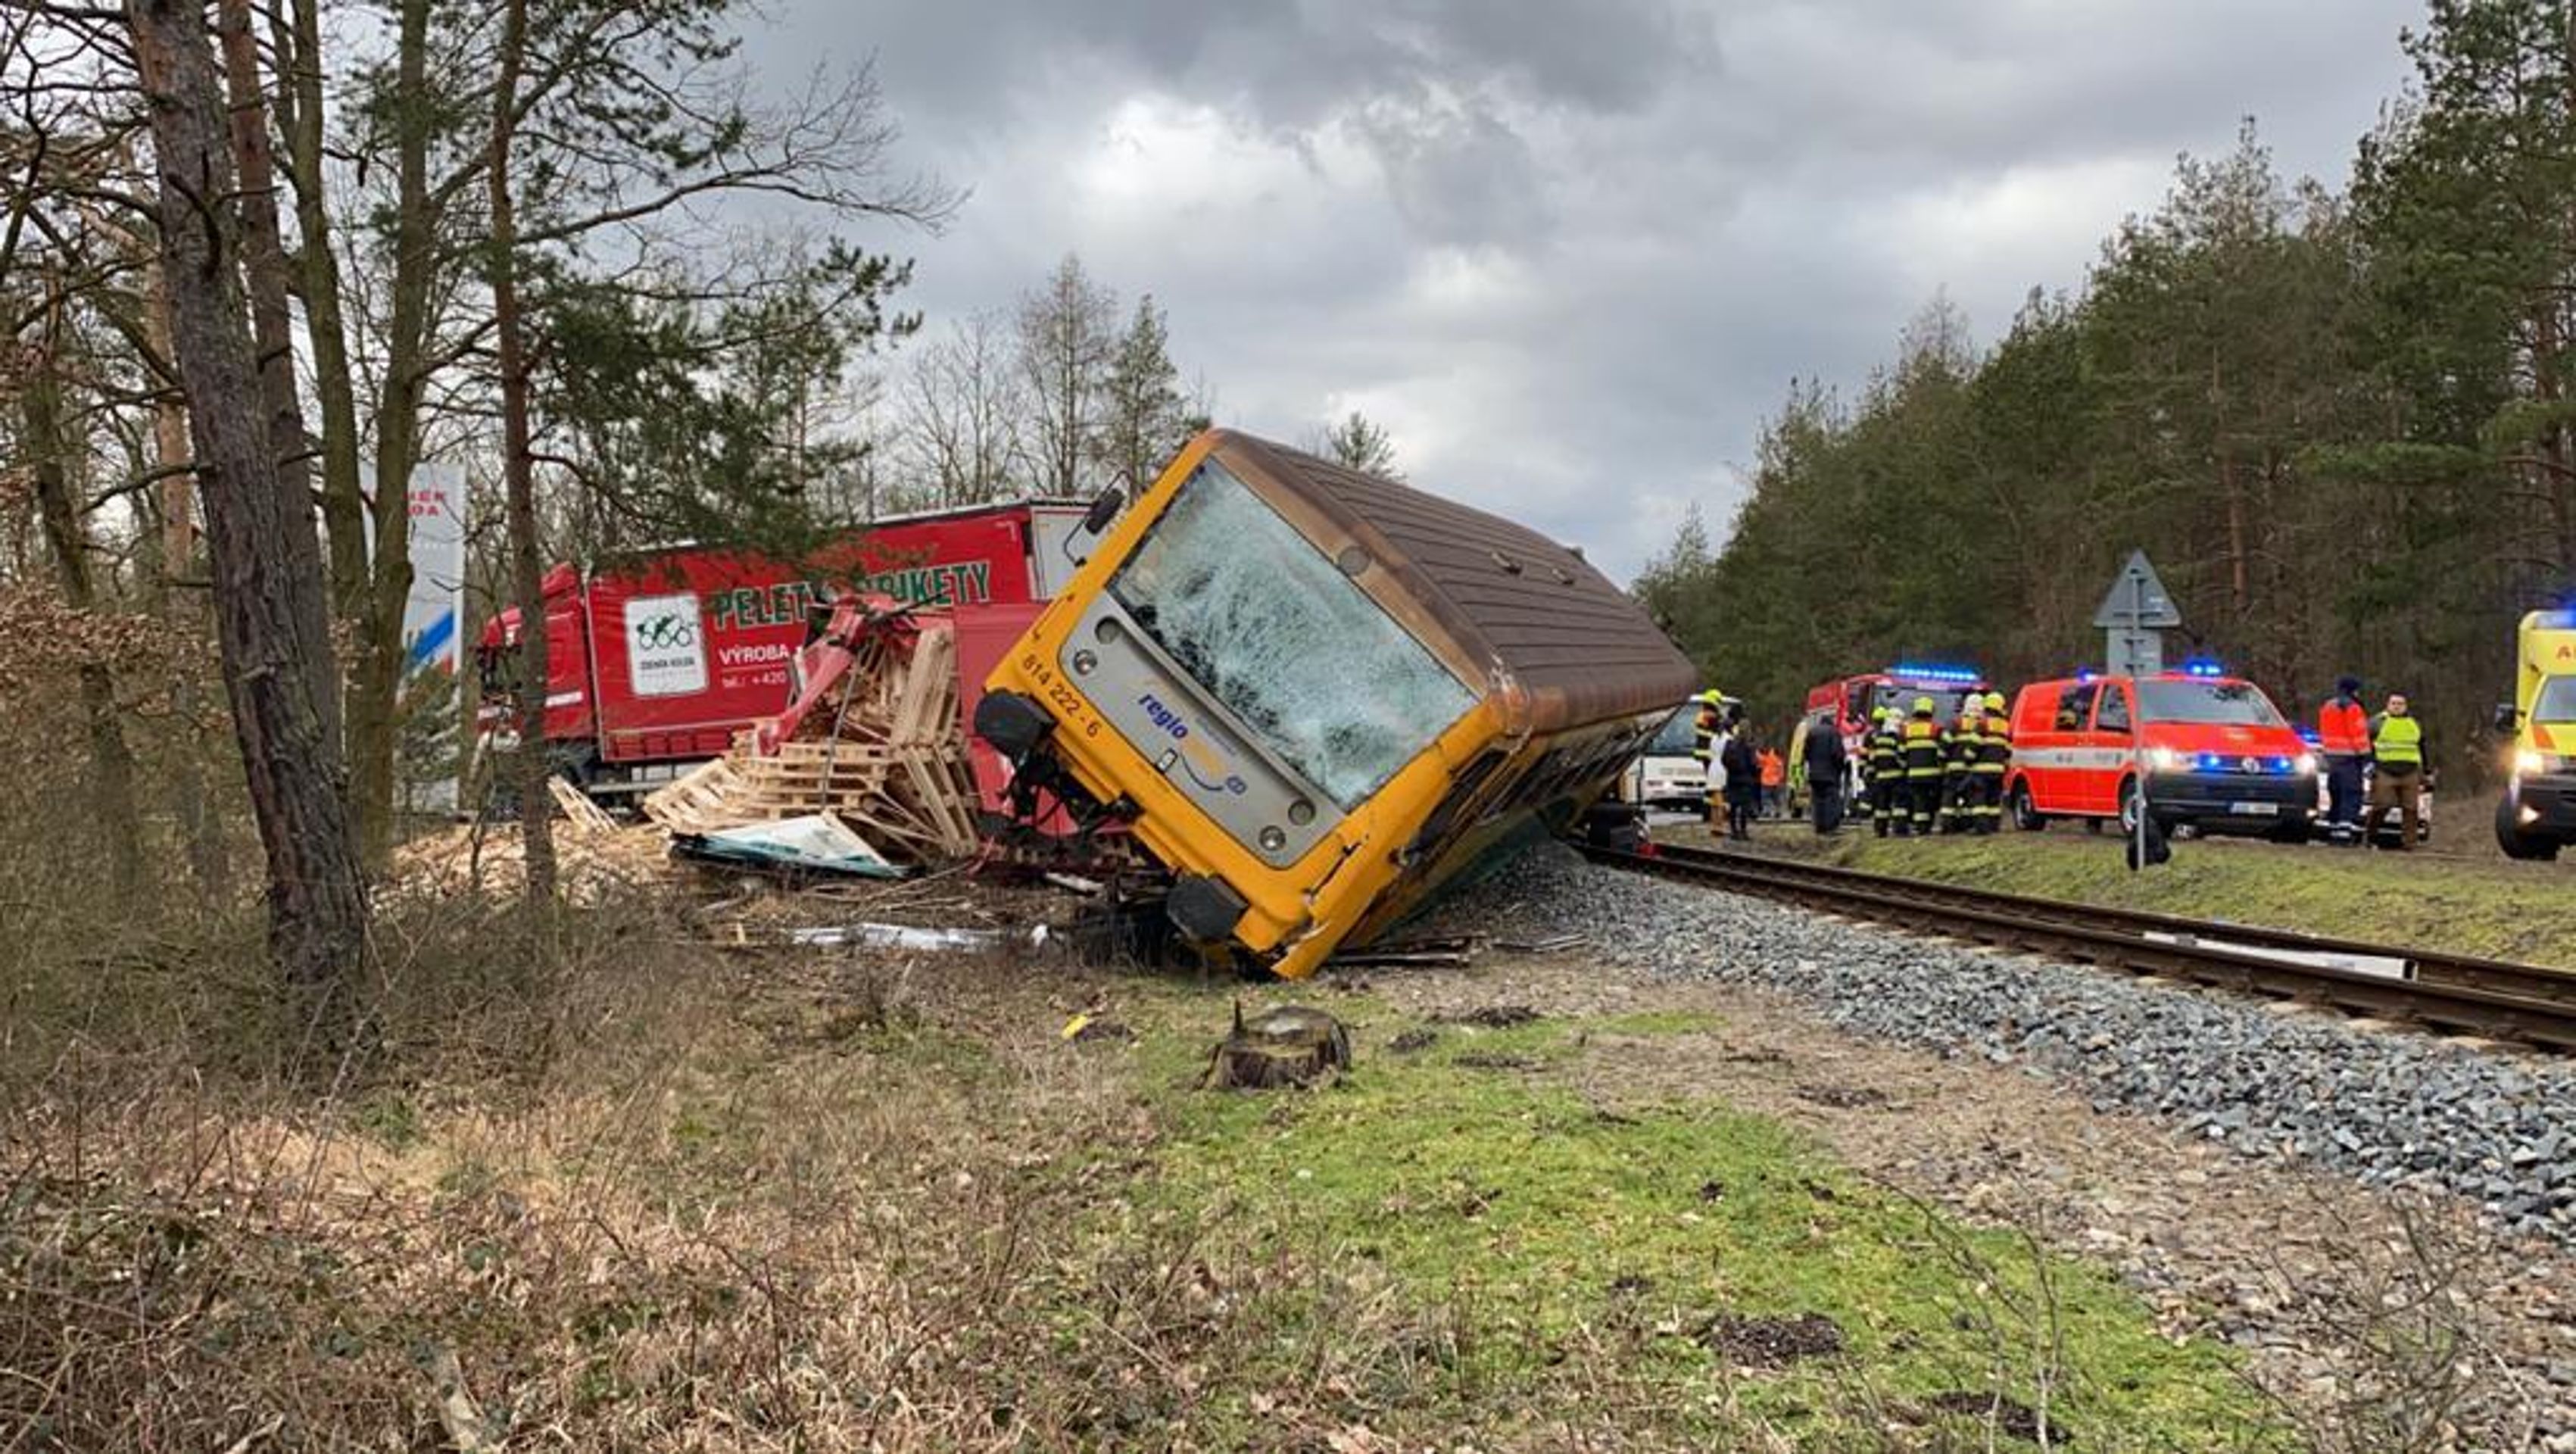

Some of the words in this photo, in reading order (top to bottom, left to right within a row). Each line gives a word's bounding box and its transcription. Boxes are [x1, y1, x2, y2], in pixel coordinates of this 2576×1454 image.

[714, 582, 818, 631] PELET
[859, 560, 990, 606] RIKETY
[719, 644, 790, 665] VÝROBA
[1049, 683, 1081, 717] 222
[1086, 722, 1102, 738] 6
[1138, 694, 1188, 739] regio
